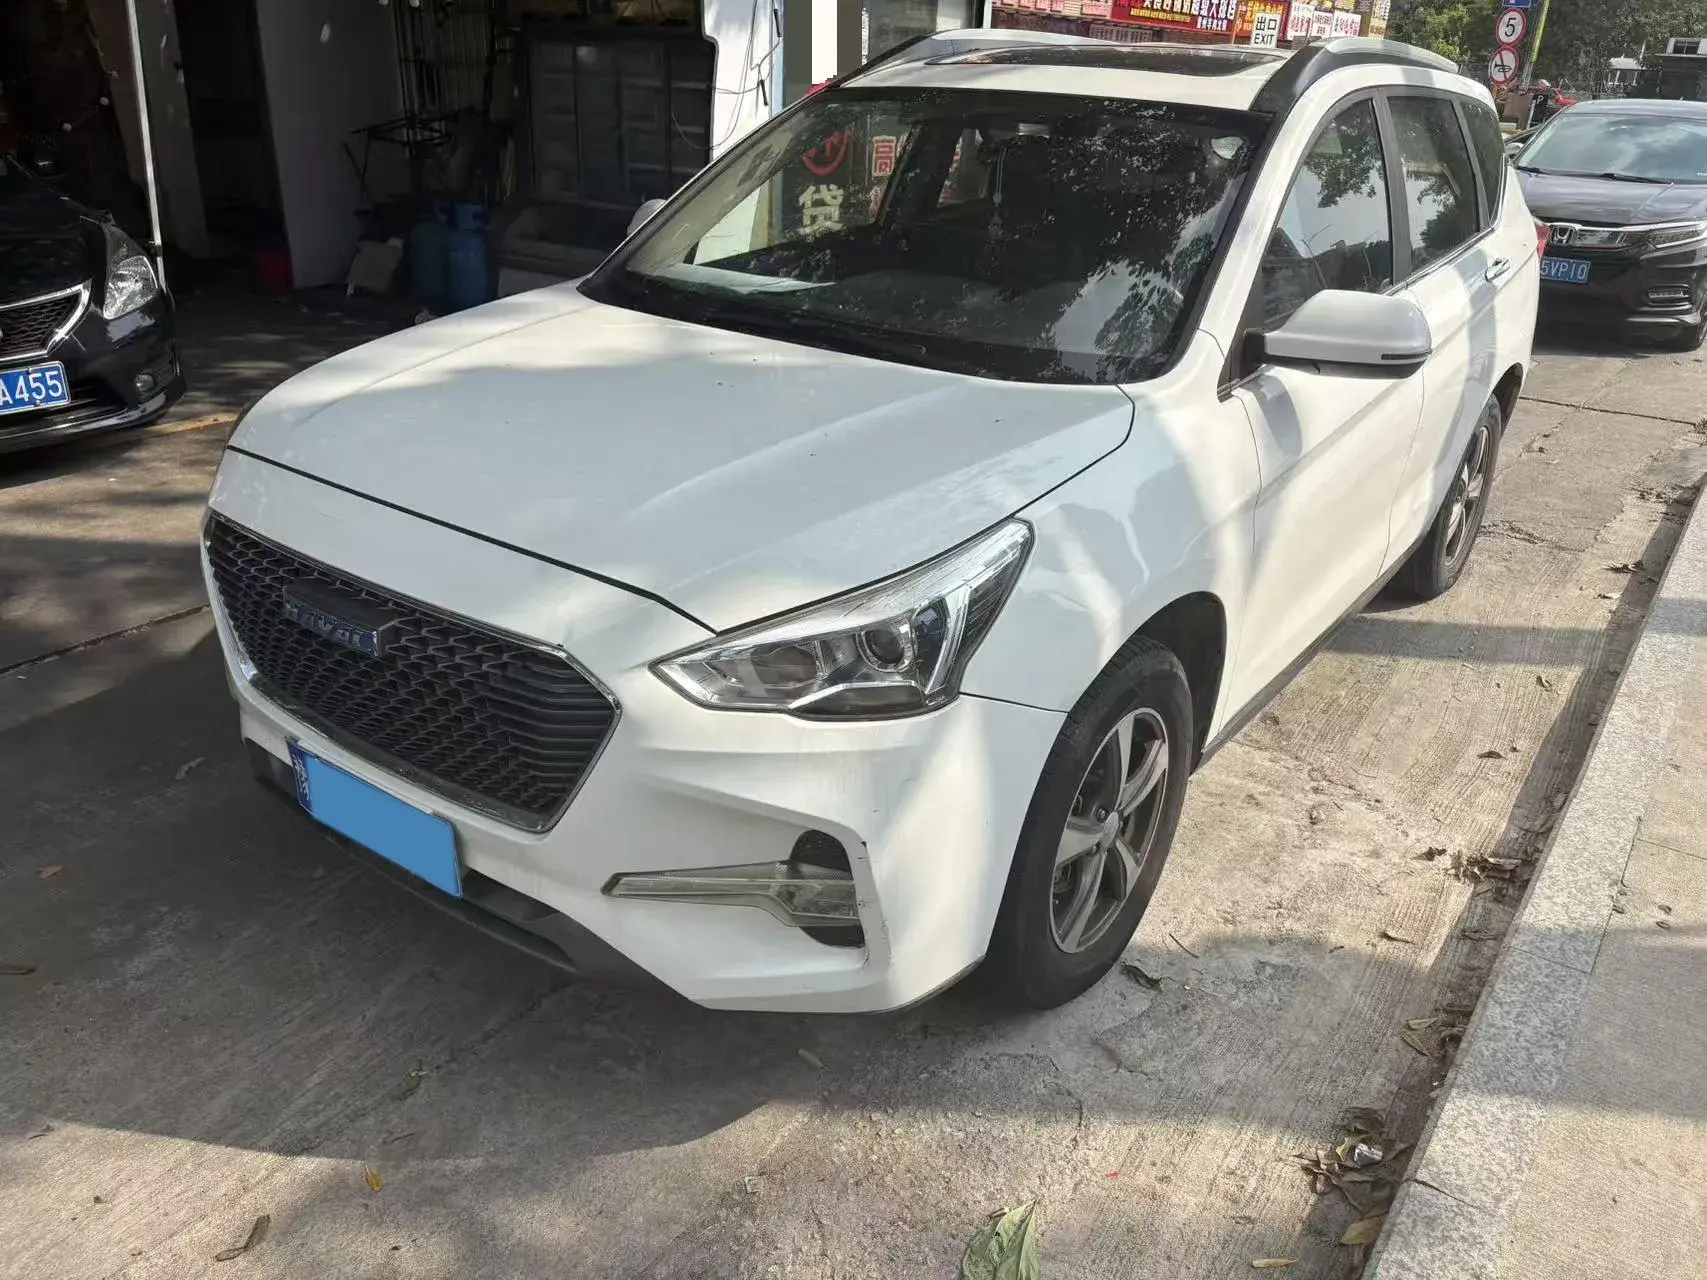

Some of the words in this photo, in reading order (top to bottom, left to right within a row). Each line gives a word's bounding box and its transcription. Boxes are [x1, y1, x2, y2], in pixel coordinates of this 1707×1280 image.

[1255, 16, 1277, 31] 出口
[1504, 17, 1516, 37] 5
[1254, 33, 1275, 45] EXIT
[797, 184, 844, 233] 贷
[0, 370, 63, 406] A455
